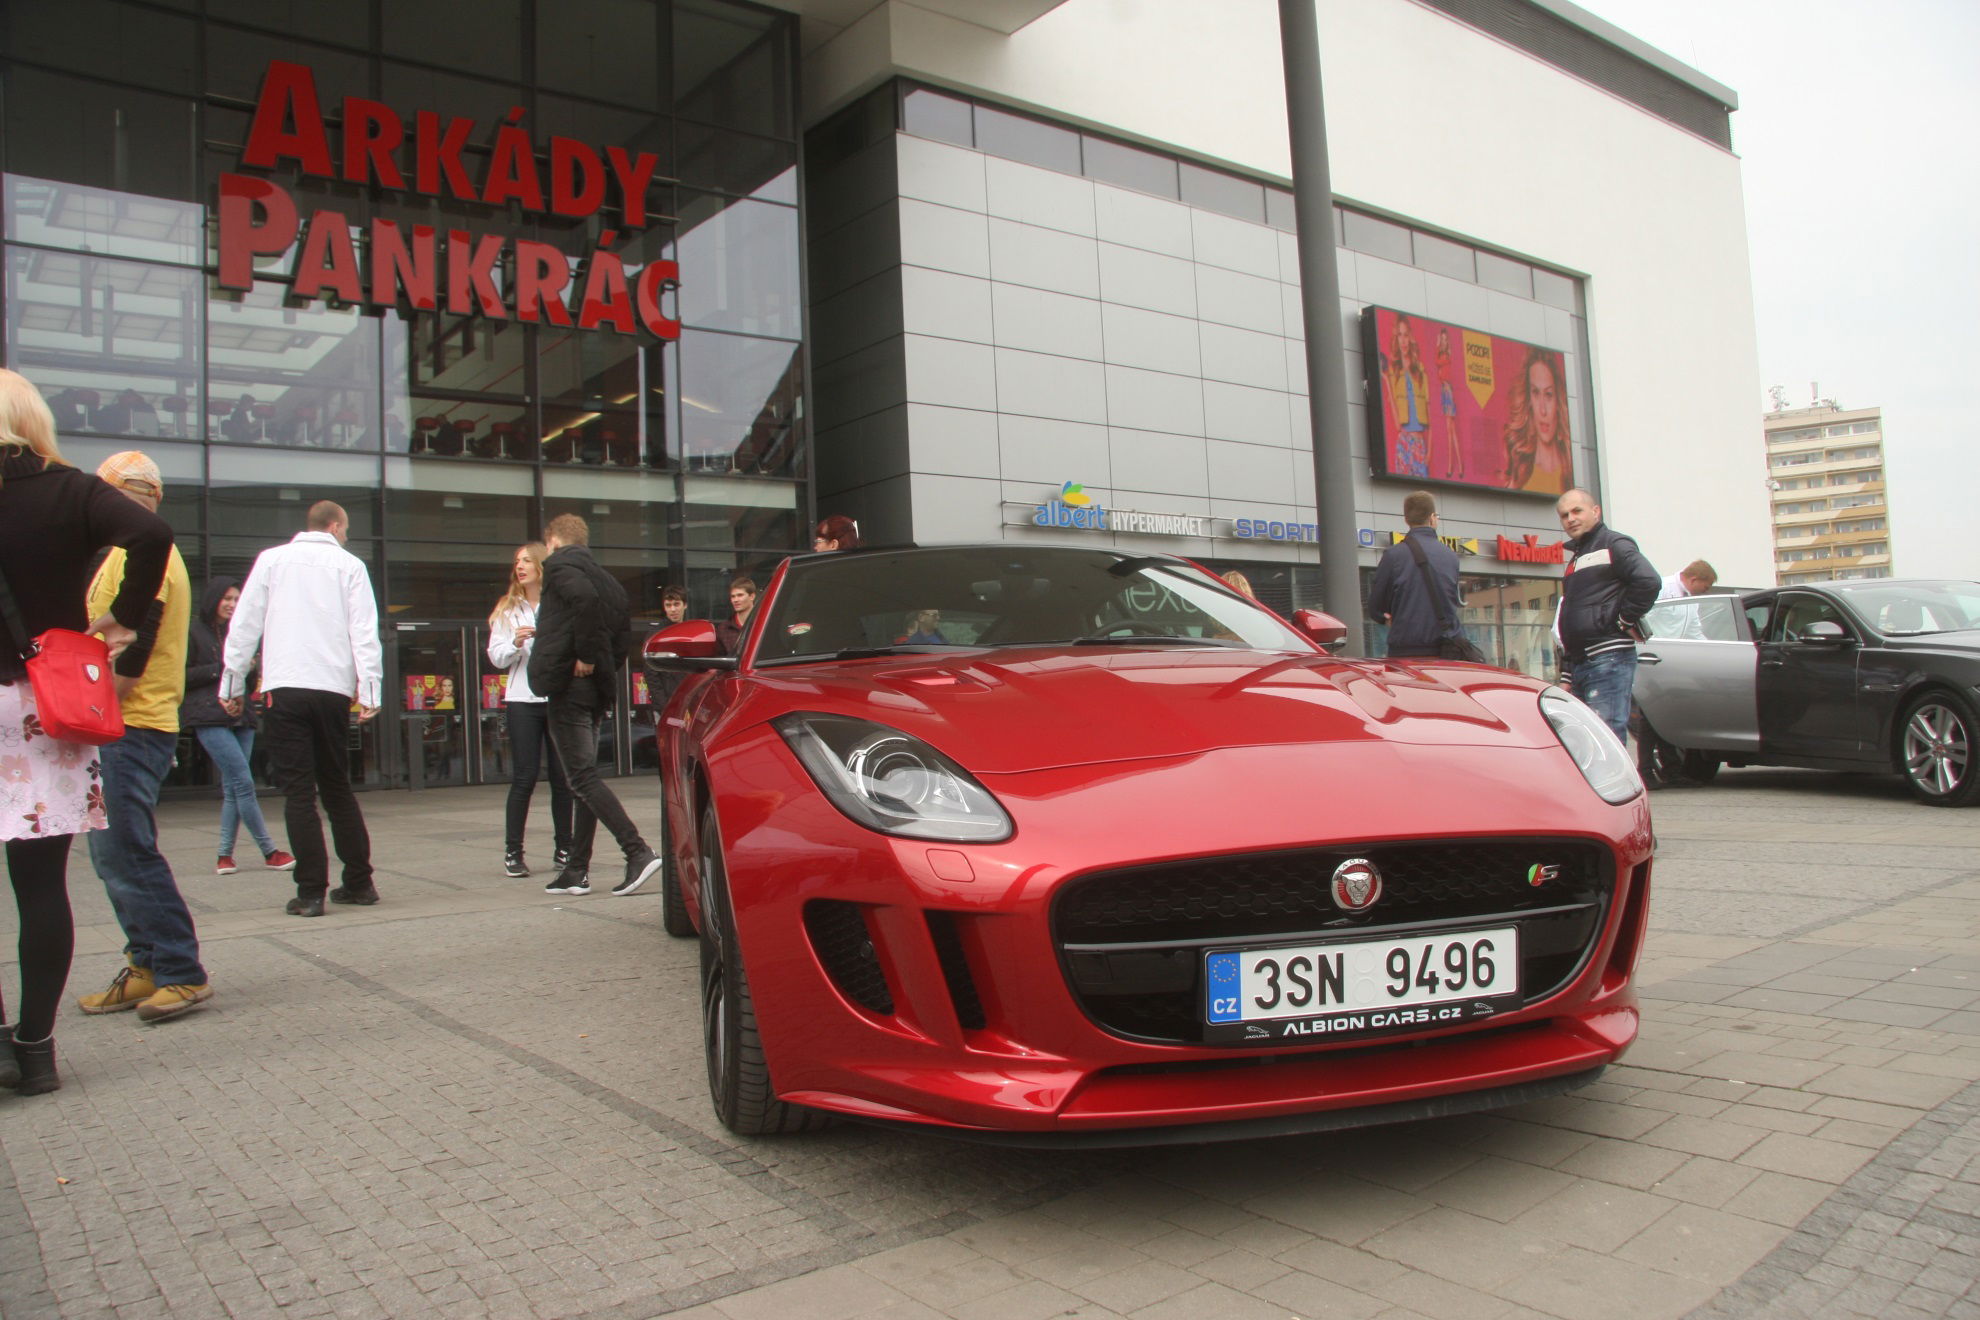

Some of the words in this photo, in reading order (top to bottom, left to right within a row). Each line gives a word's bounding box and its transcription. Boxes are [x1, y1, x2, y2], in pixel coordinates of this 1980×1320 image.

[242, 59, 659, 229] ARKÁDY
[218, 171, 681, 341] PANKRÁC
[1035, 500, 1107, 529] albert
[1112, 511, 1203, 536] HYPERMARKET
[1236, 518, 1375, 546] SPORTIO
[1253, 952, 1345, 1010] 3SN
[1385, 938, 1496, 998] 9496
[1213, 997, 1237, 1014] CZ
[1282, 1016, 1365, 1036] ALBION
